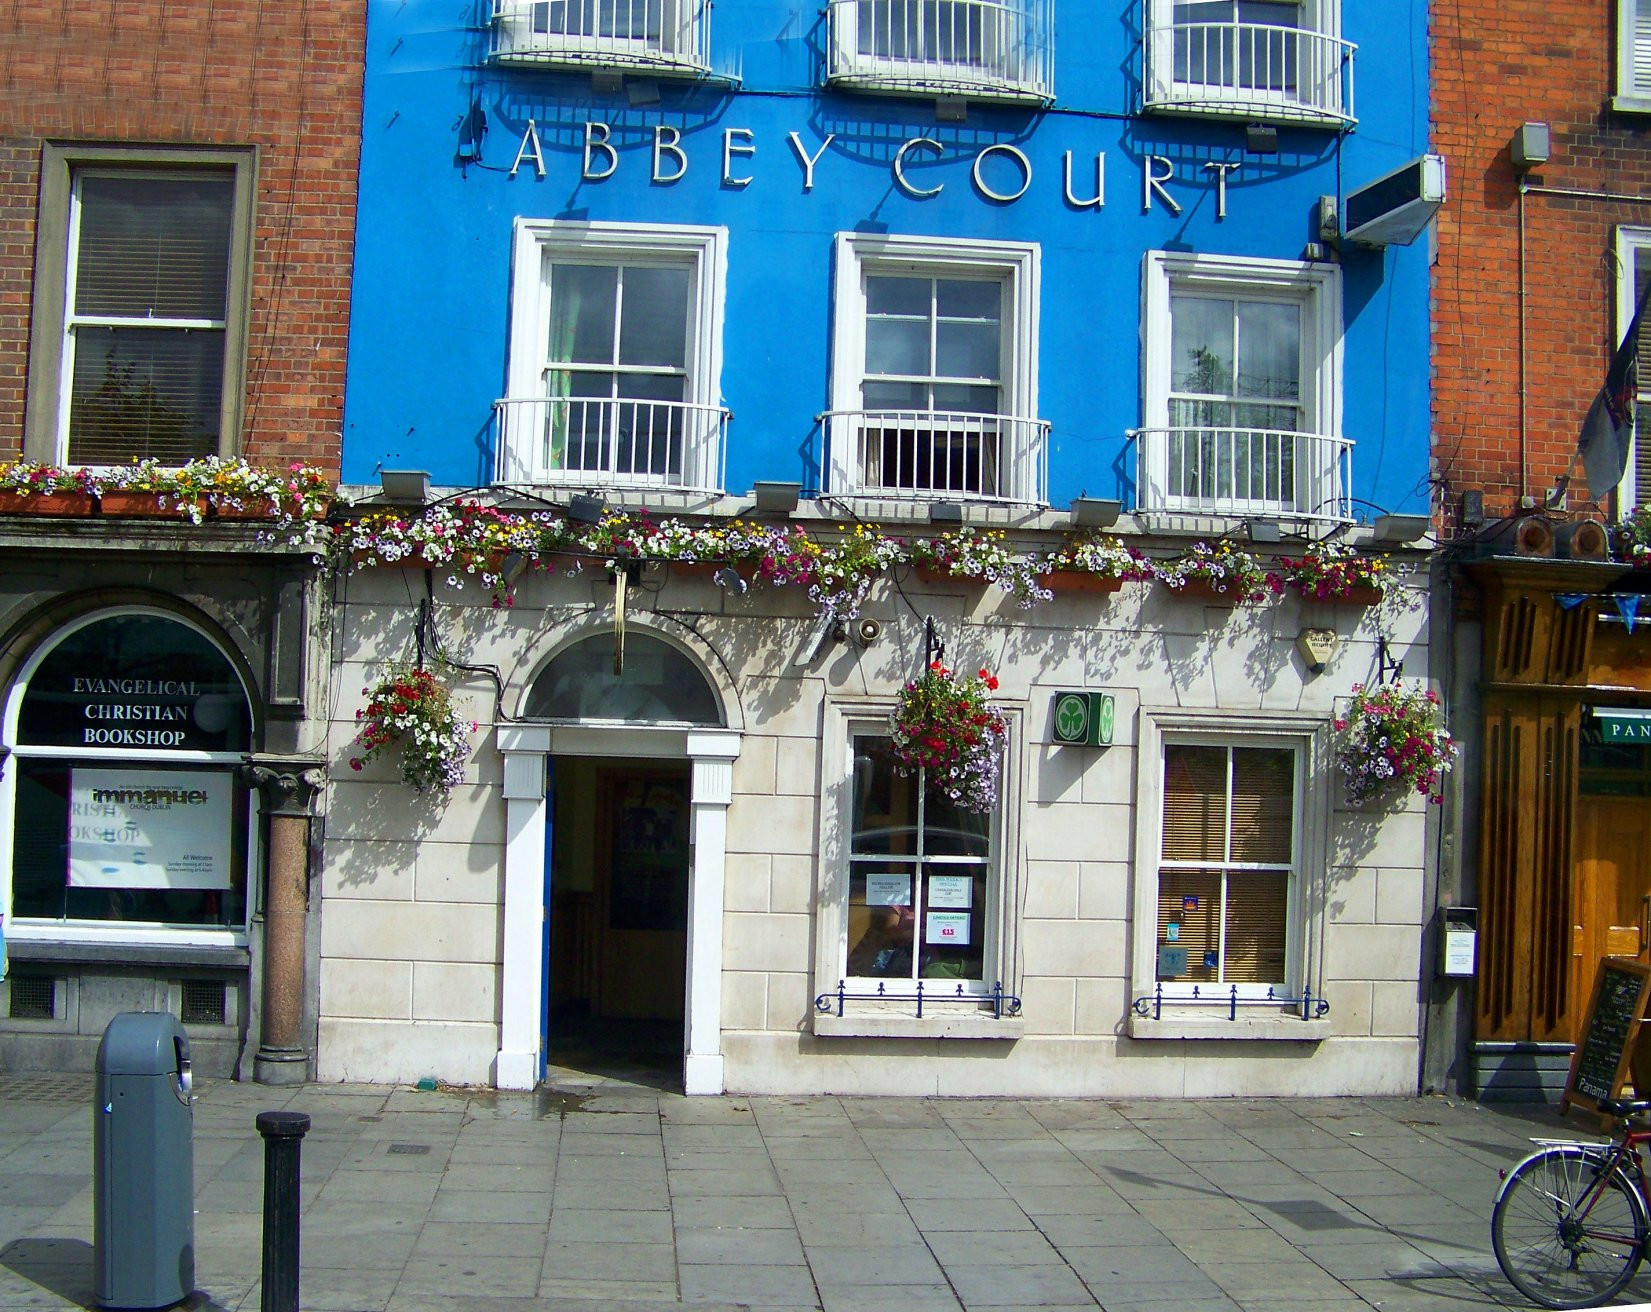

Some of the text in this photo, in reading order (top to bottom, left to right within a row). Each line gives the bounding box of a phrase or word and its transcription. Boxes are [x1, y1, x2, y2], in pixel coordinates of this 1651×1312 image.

[510, 119, 1241, 217] ABBEY COURT
[73, 678, 200, 696] EVANGELICAL
[85, 704, 188, 720] CHRISTIAN
[84, 728, 186, 746] BOOKSHOP
[92, 788, 208, 805] immanuel
[1578, 1077, 1608, 1099] Panama
